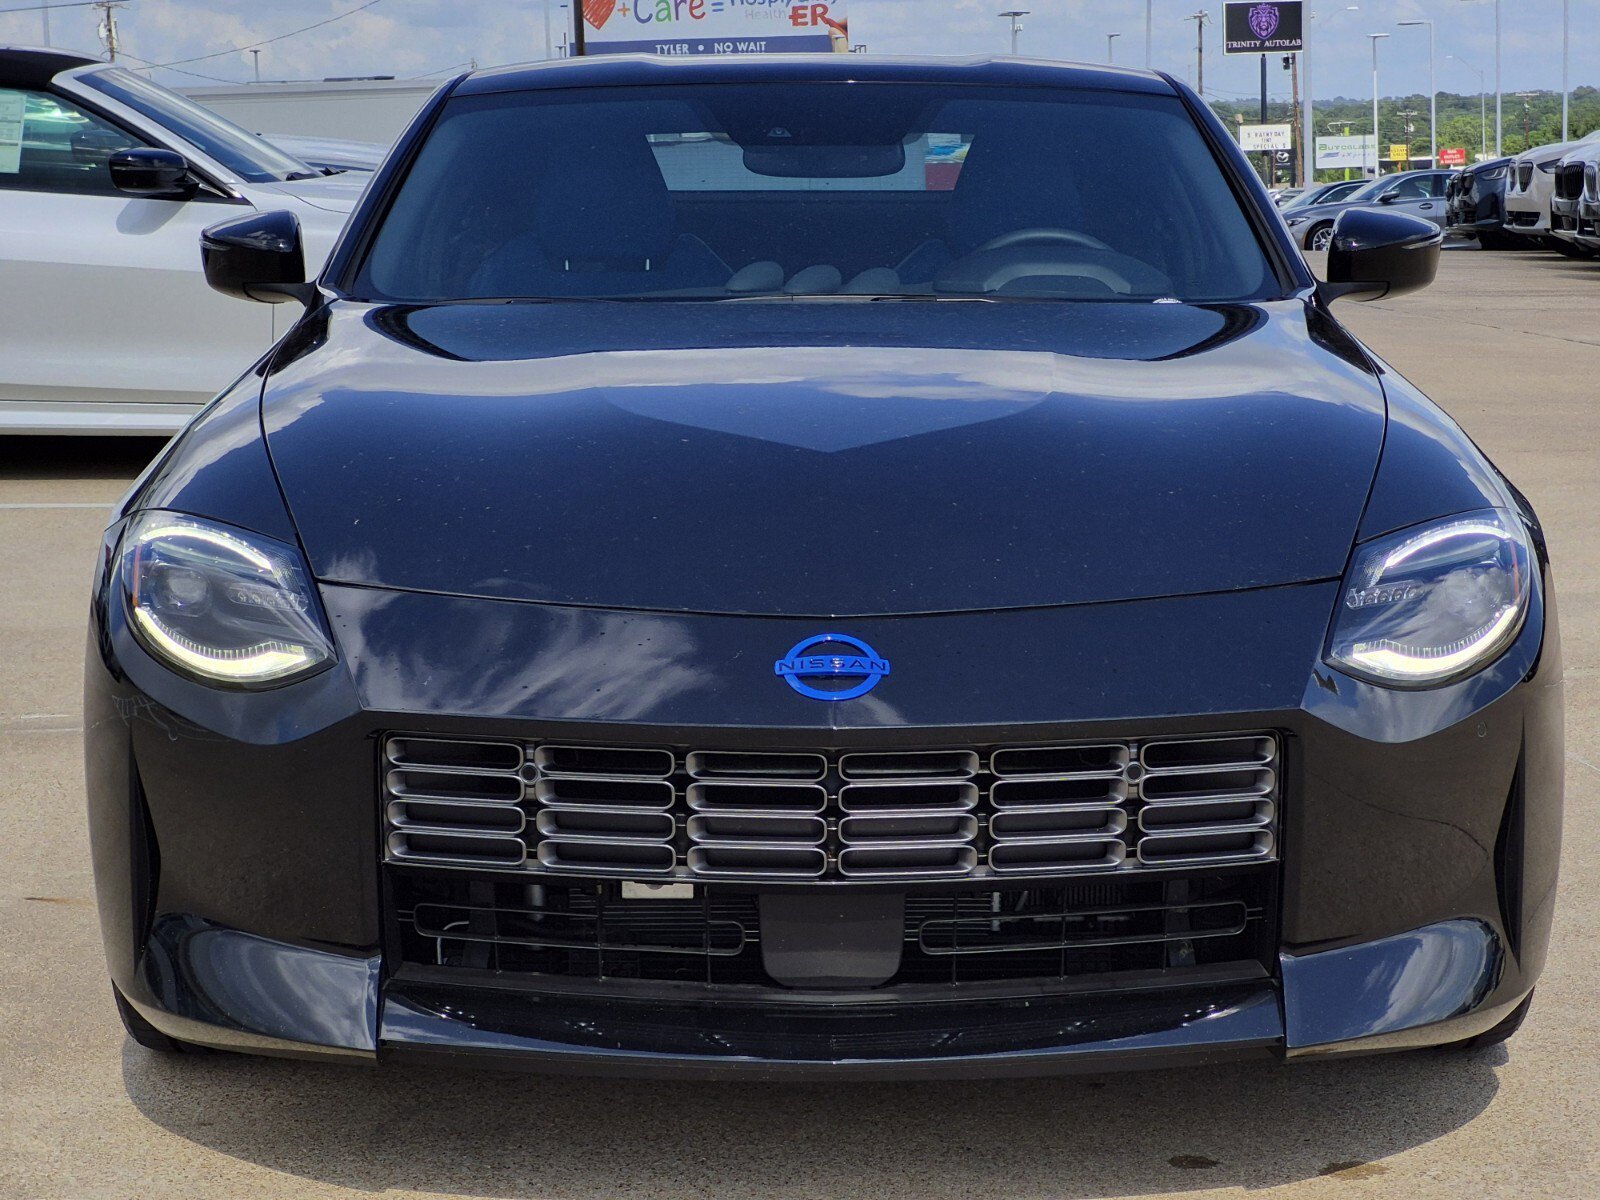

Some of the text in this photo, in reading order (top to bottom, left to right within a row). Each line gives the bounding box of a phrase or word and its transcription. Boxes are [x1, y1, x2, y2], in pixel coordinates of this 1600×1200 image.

[633, 0, 706, 24] Care
[744, 3, 831, 27] Health ER
[655, 41, 767, 55] TYLER NO WAIT
[1226, 39, 1302, 49] TRINITY AUTOLAB
[778, 659, 886, 672] NISSAN
